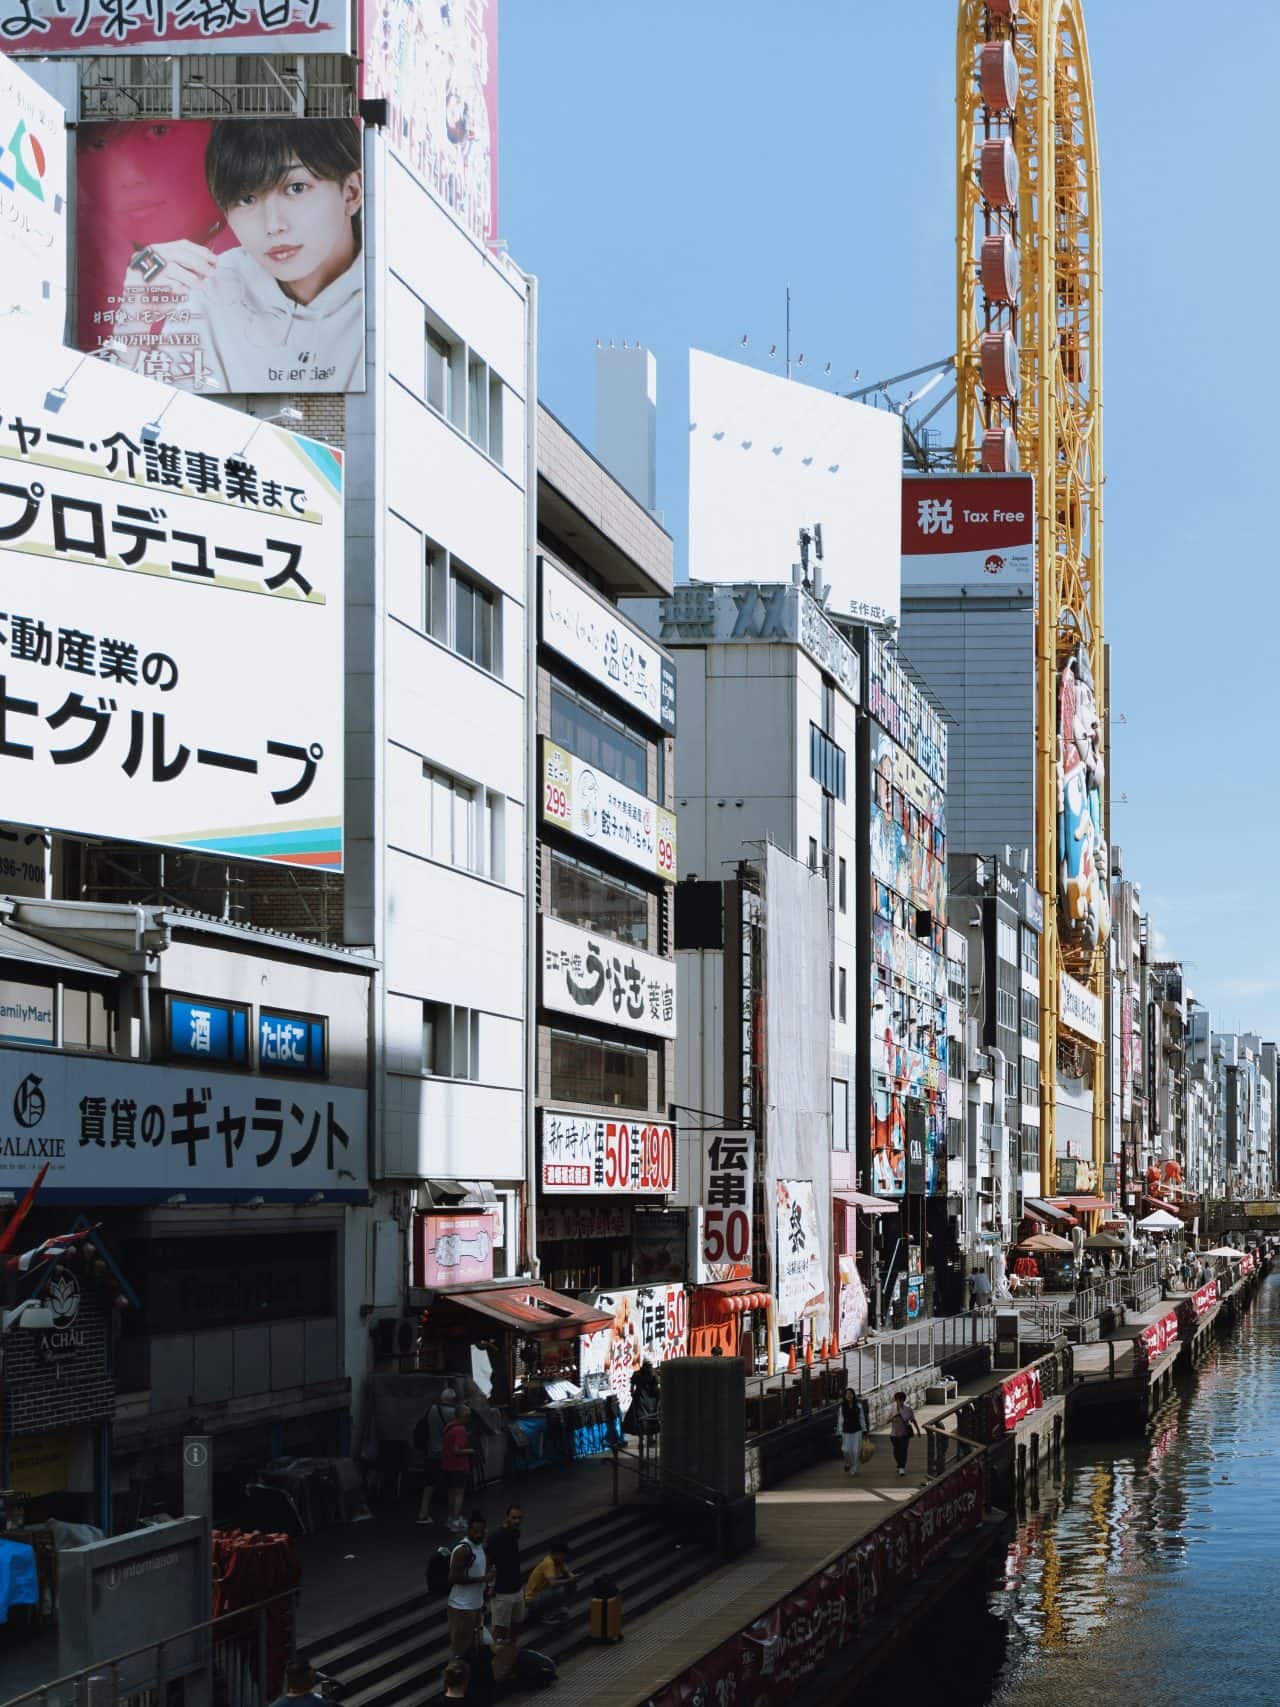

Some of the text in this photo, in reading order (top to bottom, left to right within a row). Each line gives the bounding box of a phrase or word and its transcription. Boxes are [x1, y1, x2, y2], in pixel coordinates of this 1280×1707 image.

[0, 414, 309, 514] ャー・介護事業まで
[0, 480, 313, 596] プロデュース
[917, 498, 954, 536] 税
[962, 509, 1026, 523] Tax Free
[189, 1008, 212, 1053] 酒
[260, 1021, 306, 1063] たばこ
[78, 1087, 350, 1171] 賃貸のギャラント
[605, 1123, 630, 1188] 50
[708, 1136, 749, 1209] 伝串
[704, 1210, 750, 1263] 50
[666, 1290, 685, 1341] 50
